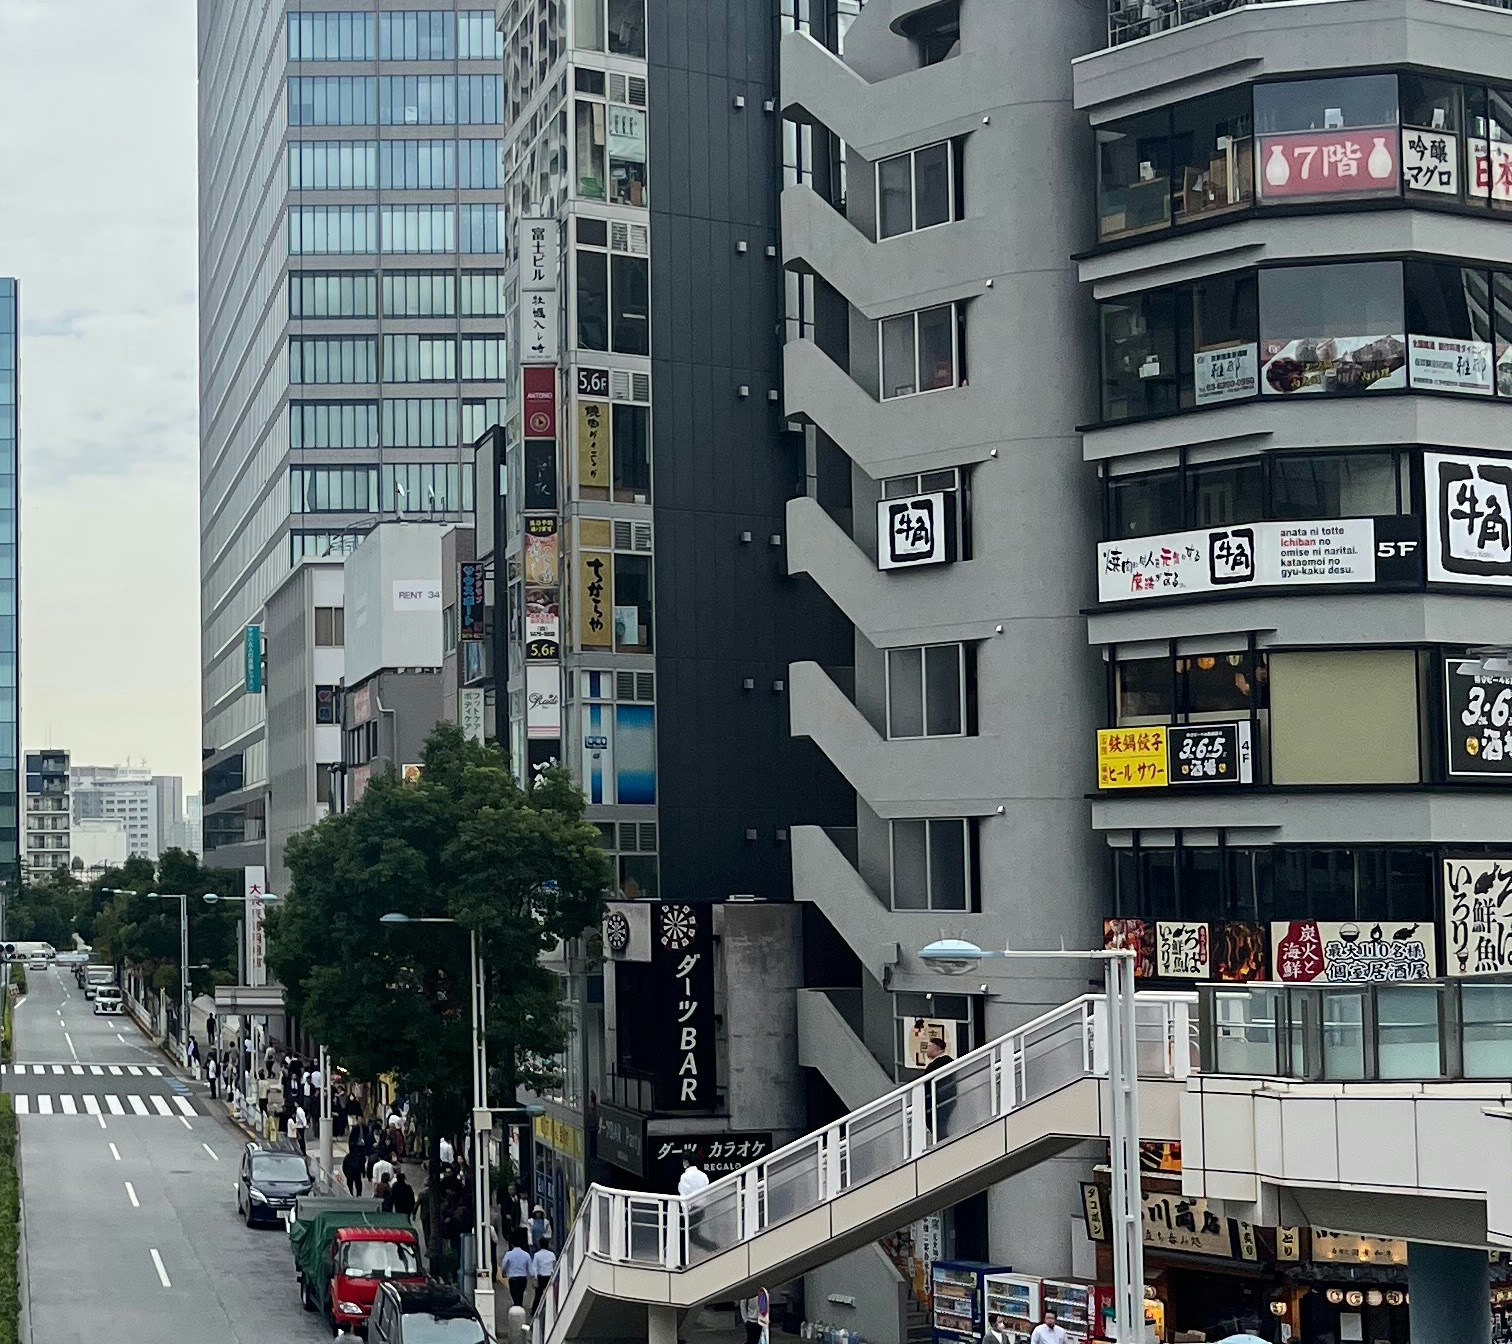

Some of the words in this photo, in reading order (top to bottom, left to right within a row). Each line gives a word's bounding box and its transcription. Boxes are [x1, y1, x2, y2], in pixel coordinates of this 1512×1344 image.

[1293, 140, 1363, 181] 7階
[1407, 164, 1452, 188] マグロ
[531, 227, 545, 282] 富士ビル
[579, 371, 607, 394] 5,6F
[1450, 483, 1511, 551] 牛角
[894, 513, 930, 547] 牛角
[1280, 528, 1307, 537] anata
[1310, 527, 1319, 536] ni
[1321, 526, 1345, 536] totte
[1280, 537, 1317, 547] ichiban
[1215, 540, 1250, 571] 牛角
[1280, 548, 1310, 557] omise
[1312, 547, 1322, 556] ni
[1324, 546, 1358, 556] naritai.
[1377, 542, 1418, 557] 5F
[1280, 557, 1326, 567] kataomoi
[1328, 558, 1341, 566] no
[1280, 567, 1326, 578] gyu-kaku
[398, 591, 423, 599] RENT
[587, 557, 604, 632] ちからや
[530, 642, 556, 657] 5,6F
[473, 691, 481, 731] フットケア
[1241, 740, 1251, 764] 4F
[1190, 758, 1217, 777] 酒場
[1447, 862, 1472, 955] いろり
[1472, 898, 1498, 972] 鮮魚
[1283, 942, 1303, 979] 海鮮
[1298, 923, 1319, 975] 炭火と
[1326, 941, 1425, 959] 最大110名様
[1326, 960, 1431, 982] 個室居酒屋
[675, 953, 701, 1102] ダーツBAR
[708, 1140, 767, 1159] カラオケ
[703, 1163, 742, 1172] REGALO
[1141, 1192, 1222, 1235] 川商店
